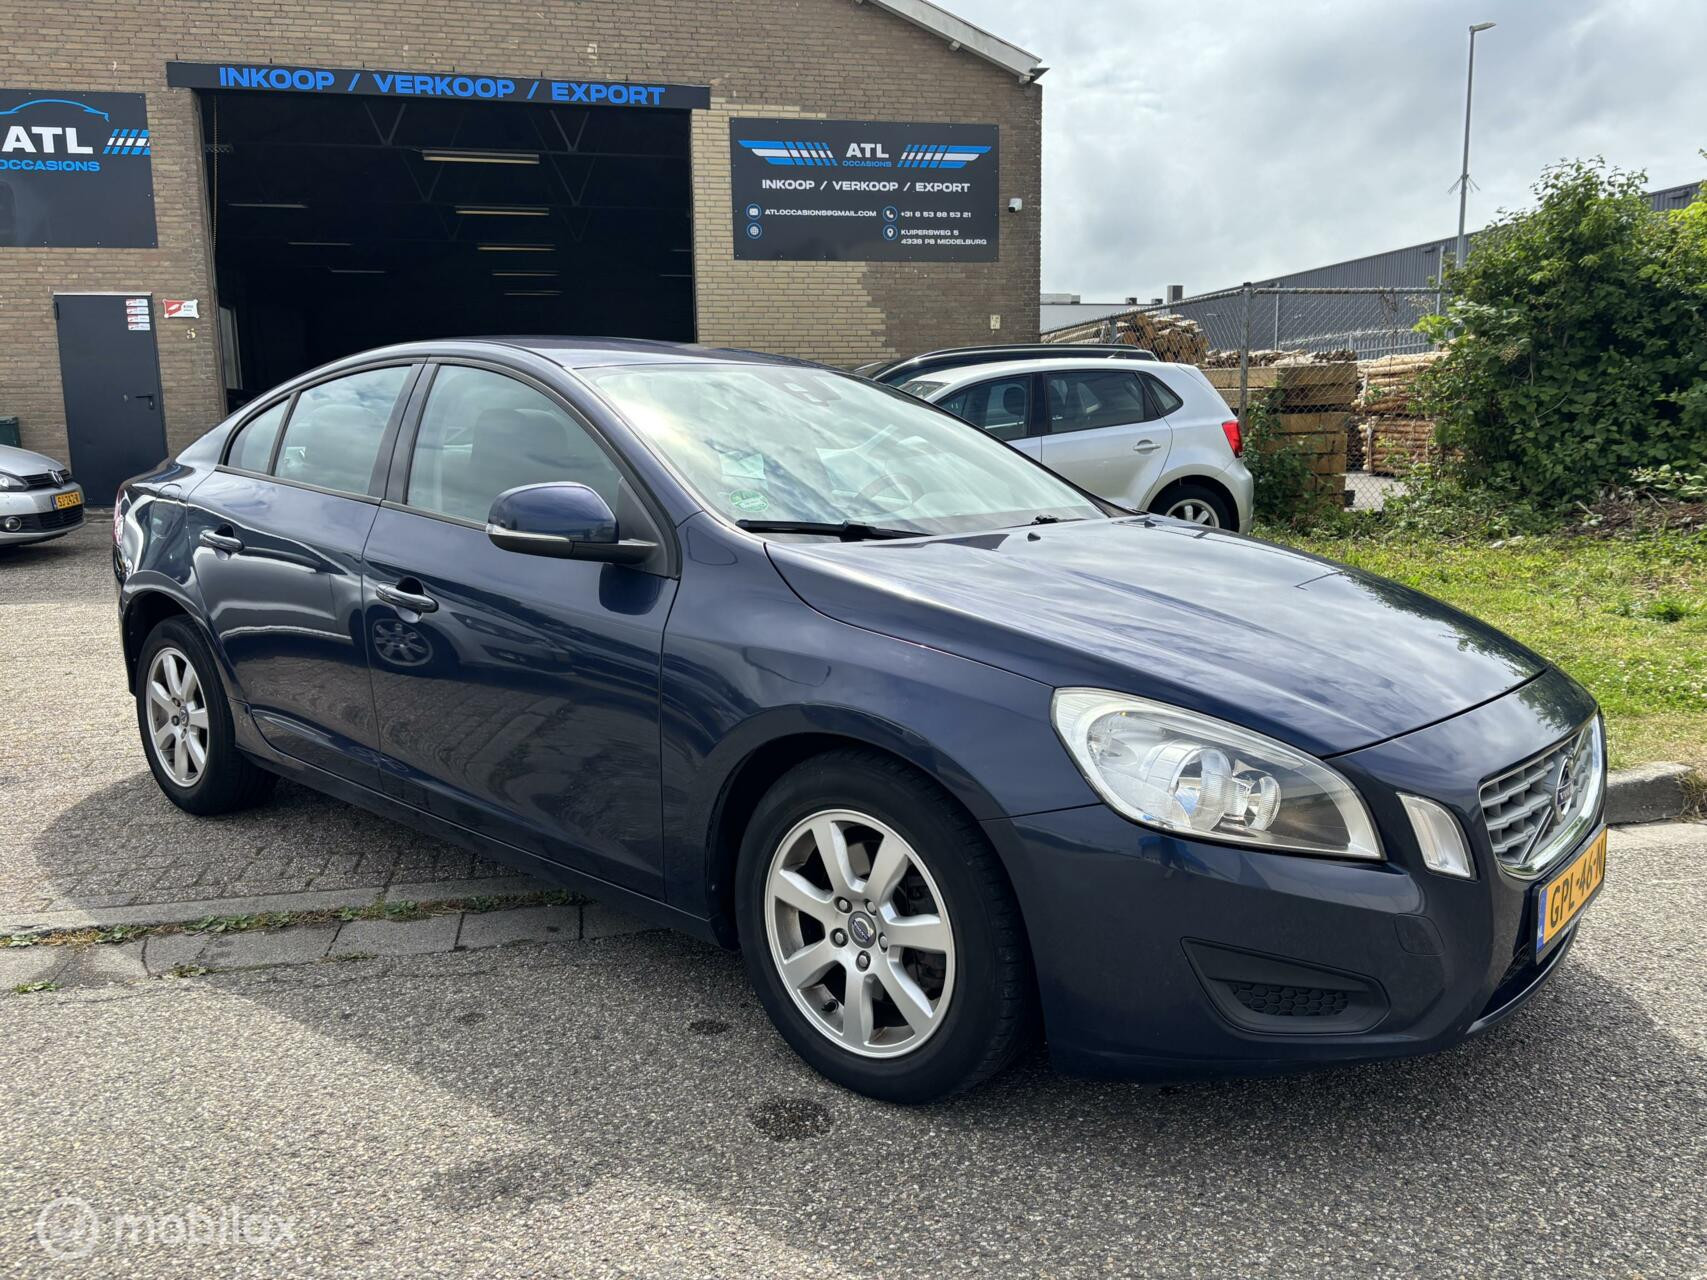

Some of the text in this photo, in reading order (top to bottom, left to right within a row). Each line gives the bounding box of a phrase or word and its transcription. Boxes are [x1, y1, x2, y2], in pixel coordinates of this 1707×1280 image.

[219, 66, 666, 105] INKOOP / VERKOOP / EXPORT
[1, 125, 94, 154] ATL
[845, 142, 889, 158] ATL
[842, 160, 892, 168] OCCASIONS
[762, 179, 971, 193] INKOOP / VERKOOP / EXPORT
[764, 209, 877, 217] ATLOCCASIONS@GMAIL.COM
